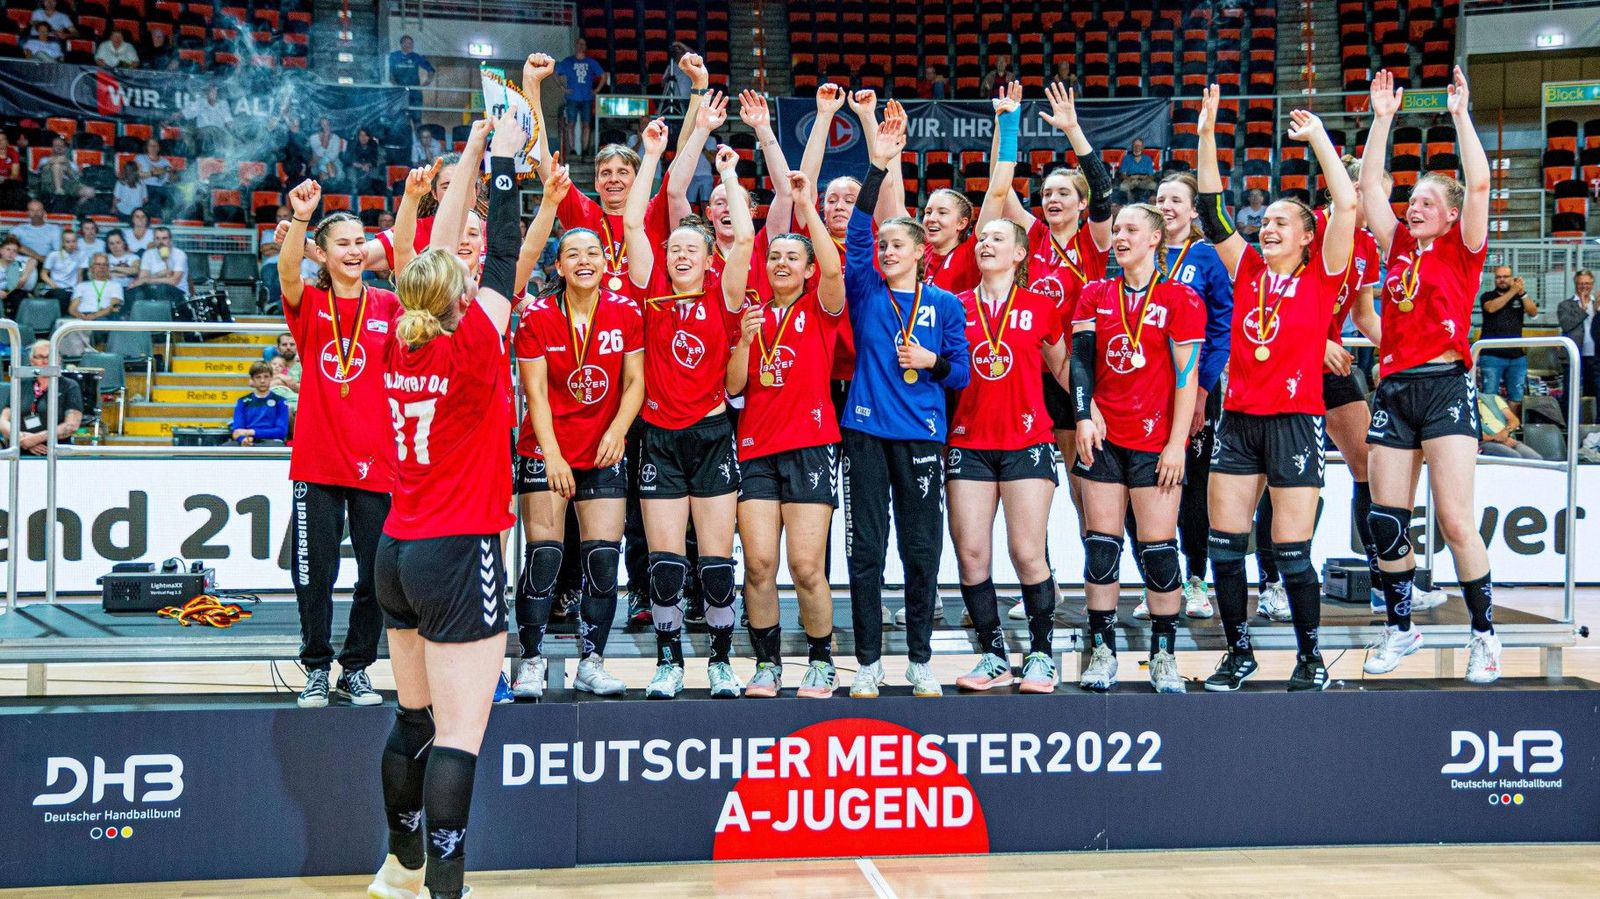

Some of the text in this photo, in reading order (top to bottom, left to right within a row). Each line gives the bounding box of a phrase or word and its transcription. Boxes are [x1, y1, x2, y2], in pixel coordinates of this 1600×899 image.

[1405, 95, 1439, 107] Block
[1548, 88, 1585, 101] Block
[916, 305, 936, 328] 21
[1008, 309, 1033, 331] 18
[1143, 302, 1168, 328] 20
[598, 328, 624, 355] 26
[676, 339, 703, 354] BAER
[204, 362, 245, 371] Reihe 6
[323, 352, 364, 367] BAER
[428, 374, 450, 396] 04
[571, 380, 606, 388] BAYER
[187, 391, 229, 400] Reihe 5
[913, 454, 937, 465] hummel
[0, 490, 149, 562] nd
[502, 736, 812, 786] DEUTSCHER
[1441, 730, 1564, 774] DHB
[32, 754, 185, 806] DHB
[1451, 778, 1562, 789] Deutscher Handballbund
[44, 808, 181, 823] Deutscher Handballbund
[714, 786, 974, 833] A-JUGEND
